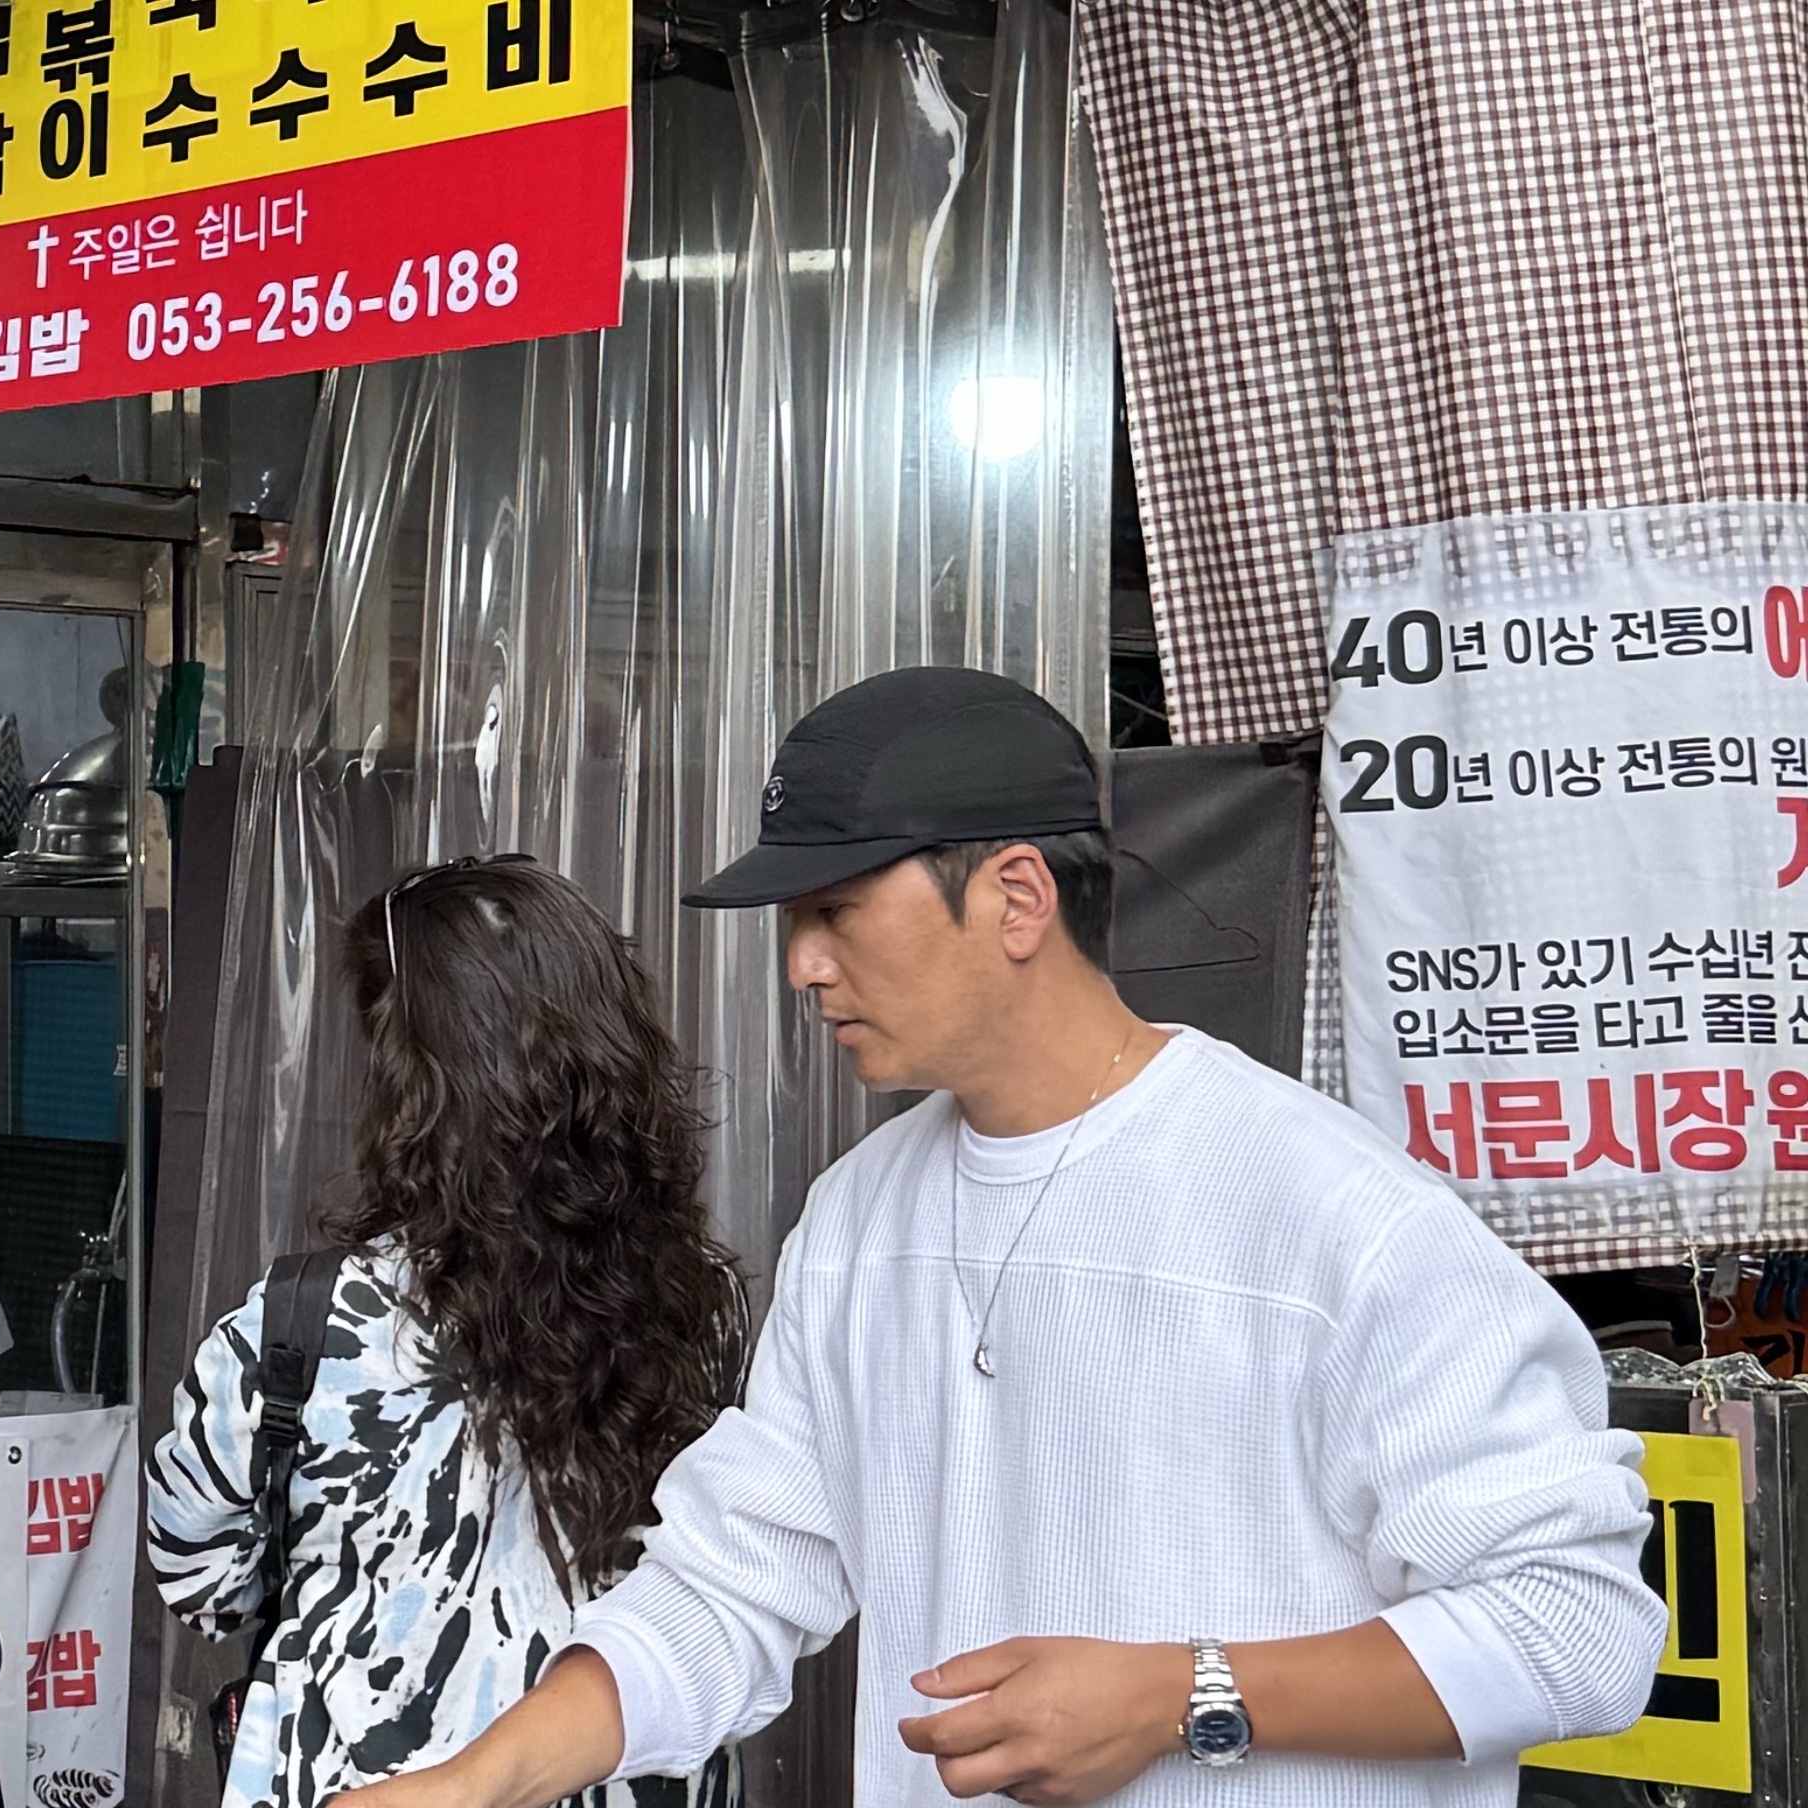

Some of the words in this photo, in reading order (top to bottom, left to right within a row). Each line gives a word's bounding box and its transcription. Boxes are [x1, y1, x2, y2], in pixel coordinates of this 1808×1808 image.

[68, 214, 180, 281] 주일은
[194, 189, 309, 261] 쉽니다
[126, 242, 520, 362] 053-256-6188
[1331, 609, 1489, 689] 40년
[1502, 614, 1599, 667] 이상
[1609, 604, 1754, 663] 전통의
[1339, 735, 1494, 814] 20년
[1508, 744, 1605, 799] 이상
[1616, 735, 1759, 794] 전통의
[1385, 942, 1526, 993] SNS가
[1536, 935, 1635, 992] 있기
[1648, 928, 1775, 983] 수십년
[1392, 1003, 1581, 1059] 입소문을
[1594, 997, 1689, 1050] 타고
[1702, 993, 1778, 1046] 줄을
[1404, 1068, 1755, 1181] 서문시장
